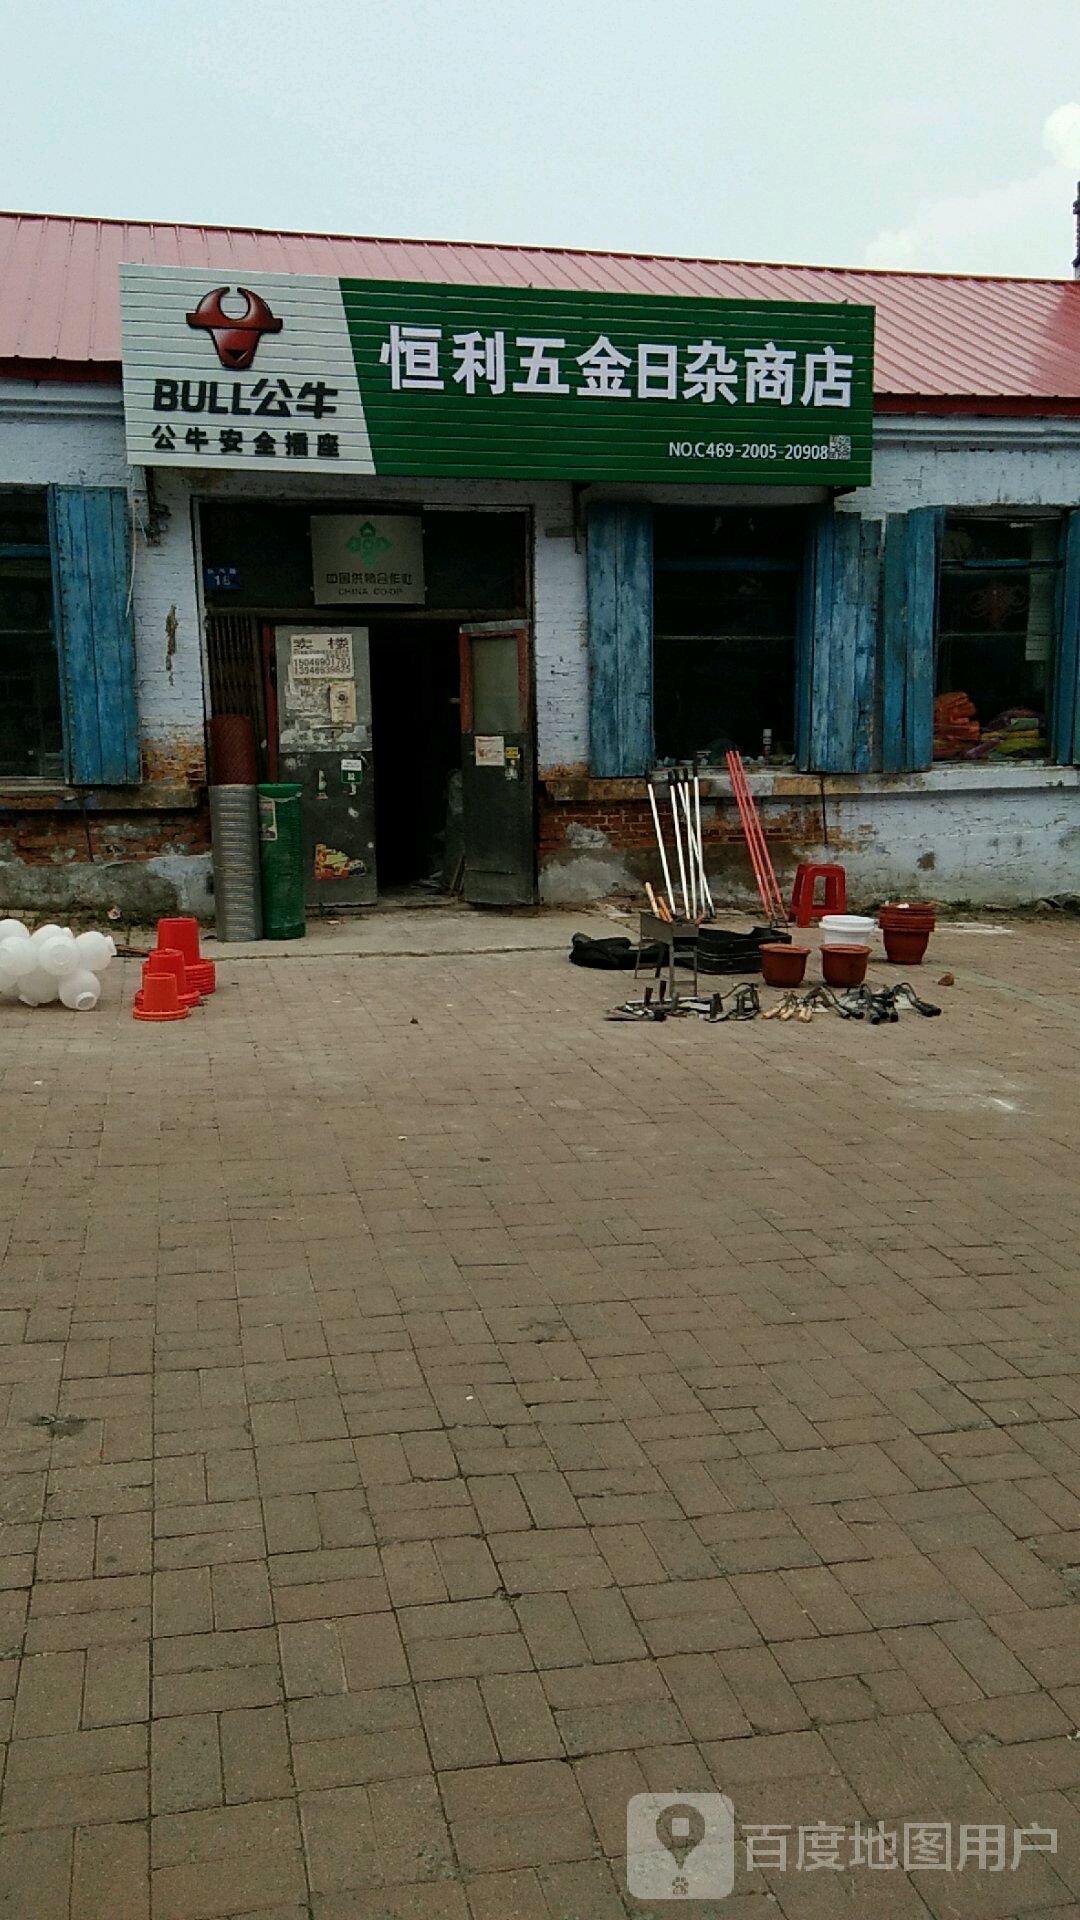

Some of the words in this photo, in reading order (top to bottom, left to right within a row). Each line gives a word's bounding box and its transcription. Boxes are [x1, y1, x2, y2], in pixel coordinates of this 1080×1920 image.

[379, 324, 854, 407] 恒利五金日杂商店
[153, 378, 338, 419] BULL公牛
[152, 424, 340, 457] 公牛安全插座
